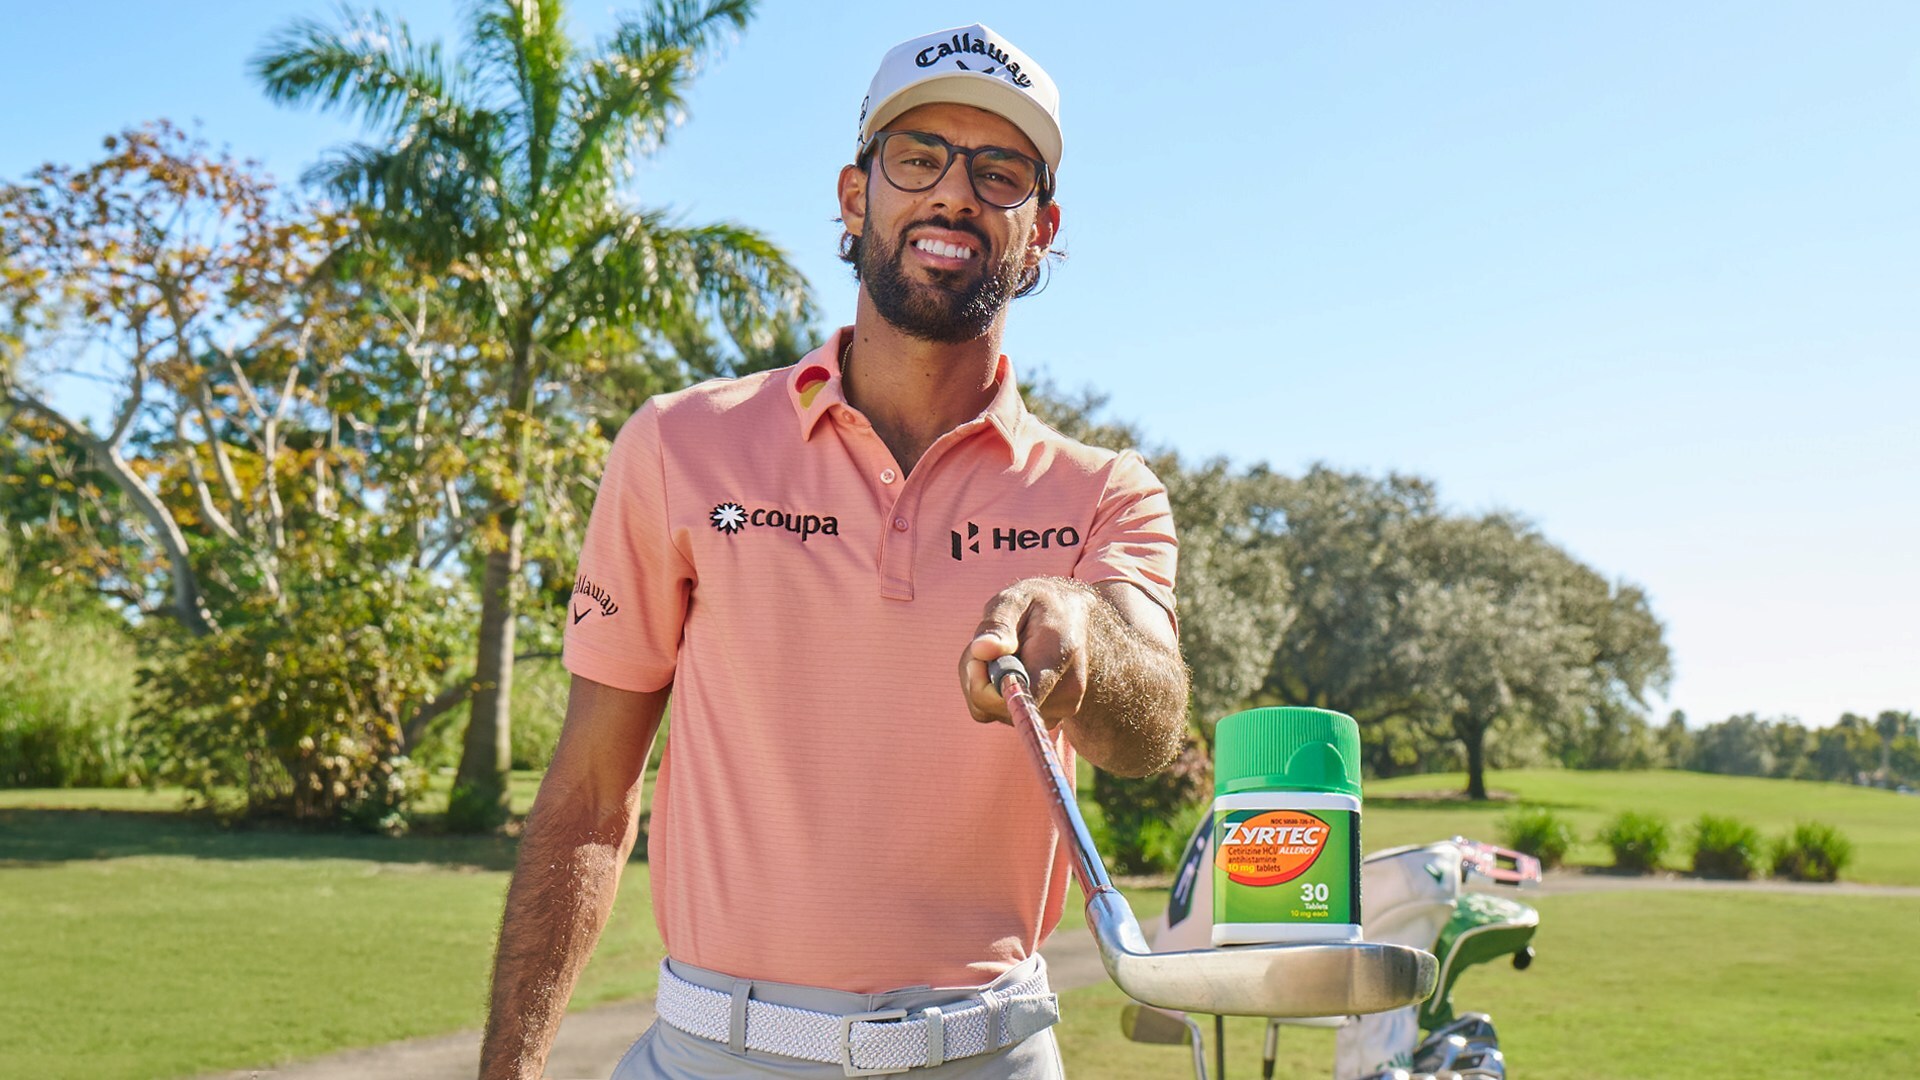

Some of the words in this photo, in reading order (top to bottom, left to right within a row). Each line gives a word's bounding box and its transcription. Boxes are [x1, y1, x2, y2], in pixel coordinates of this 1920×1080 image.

[915, 32, 1033, 89] Callaway
[750, 507, 839, 542] coupa
[992, 526, 1081, 551] Hero
[573, 574, 619, 617] allaway
[1221, 822, 1322, 845] ZYRTEC
[1228, 847, 1262, 856] Cetirizine
[1278, 846, 1317, 855] ALLERGY
[1228, 863, 1239, 872] 10
[1240, 865, 1255, 873] mg
[1256, 863, 1281, 872] tablets
[1300, 883, 1329, 902] 30
[1300, 911, 1312, 919] mg
[1304, 902, 1329, 910] Tablets
